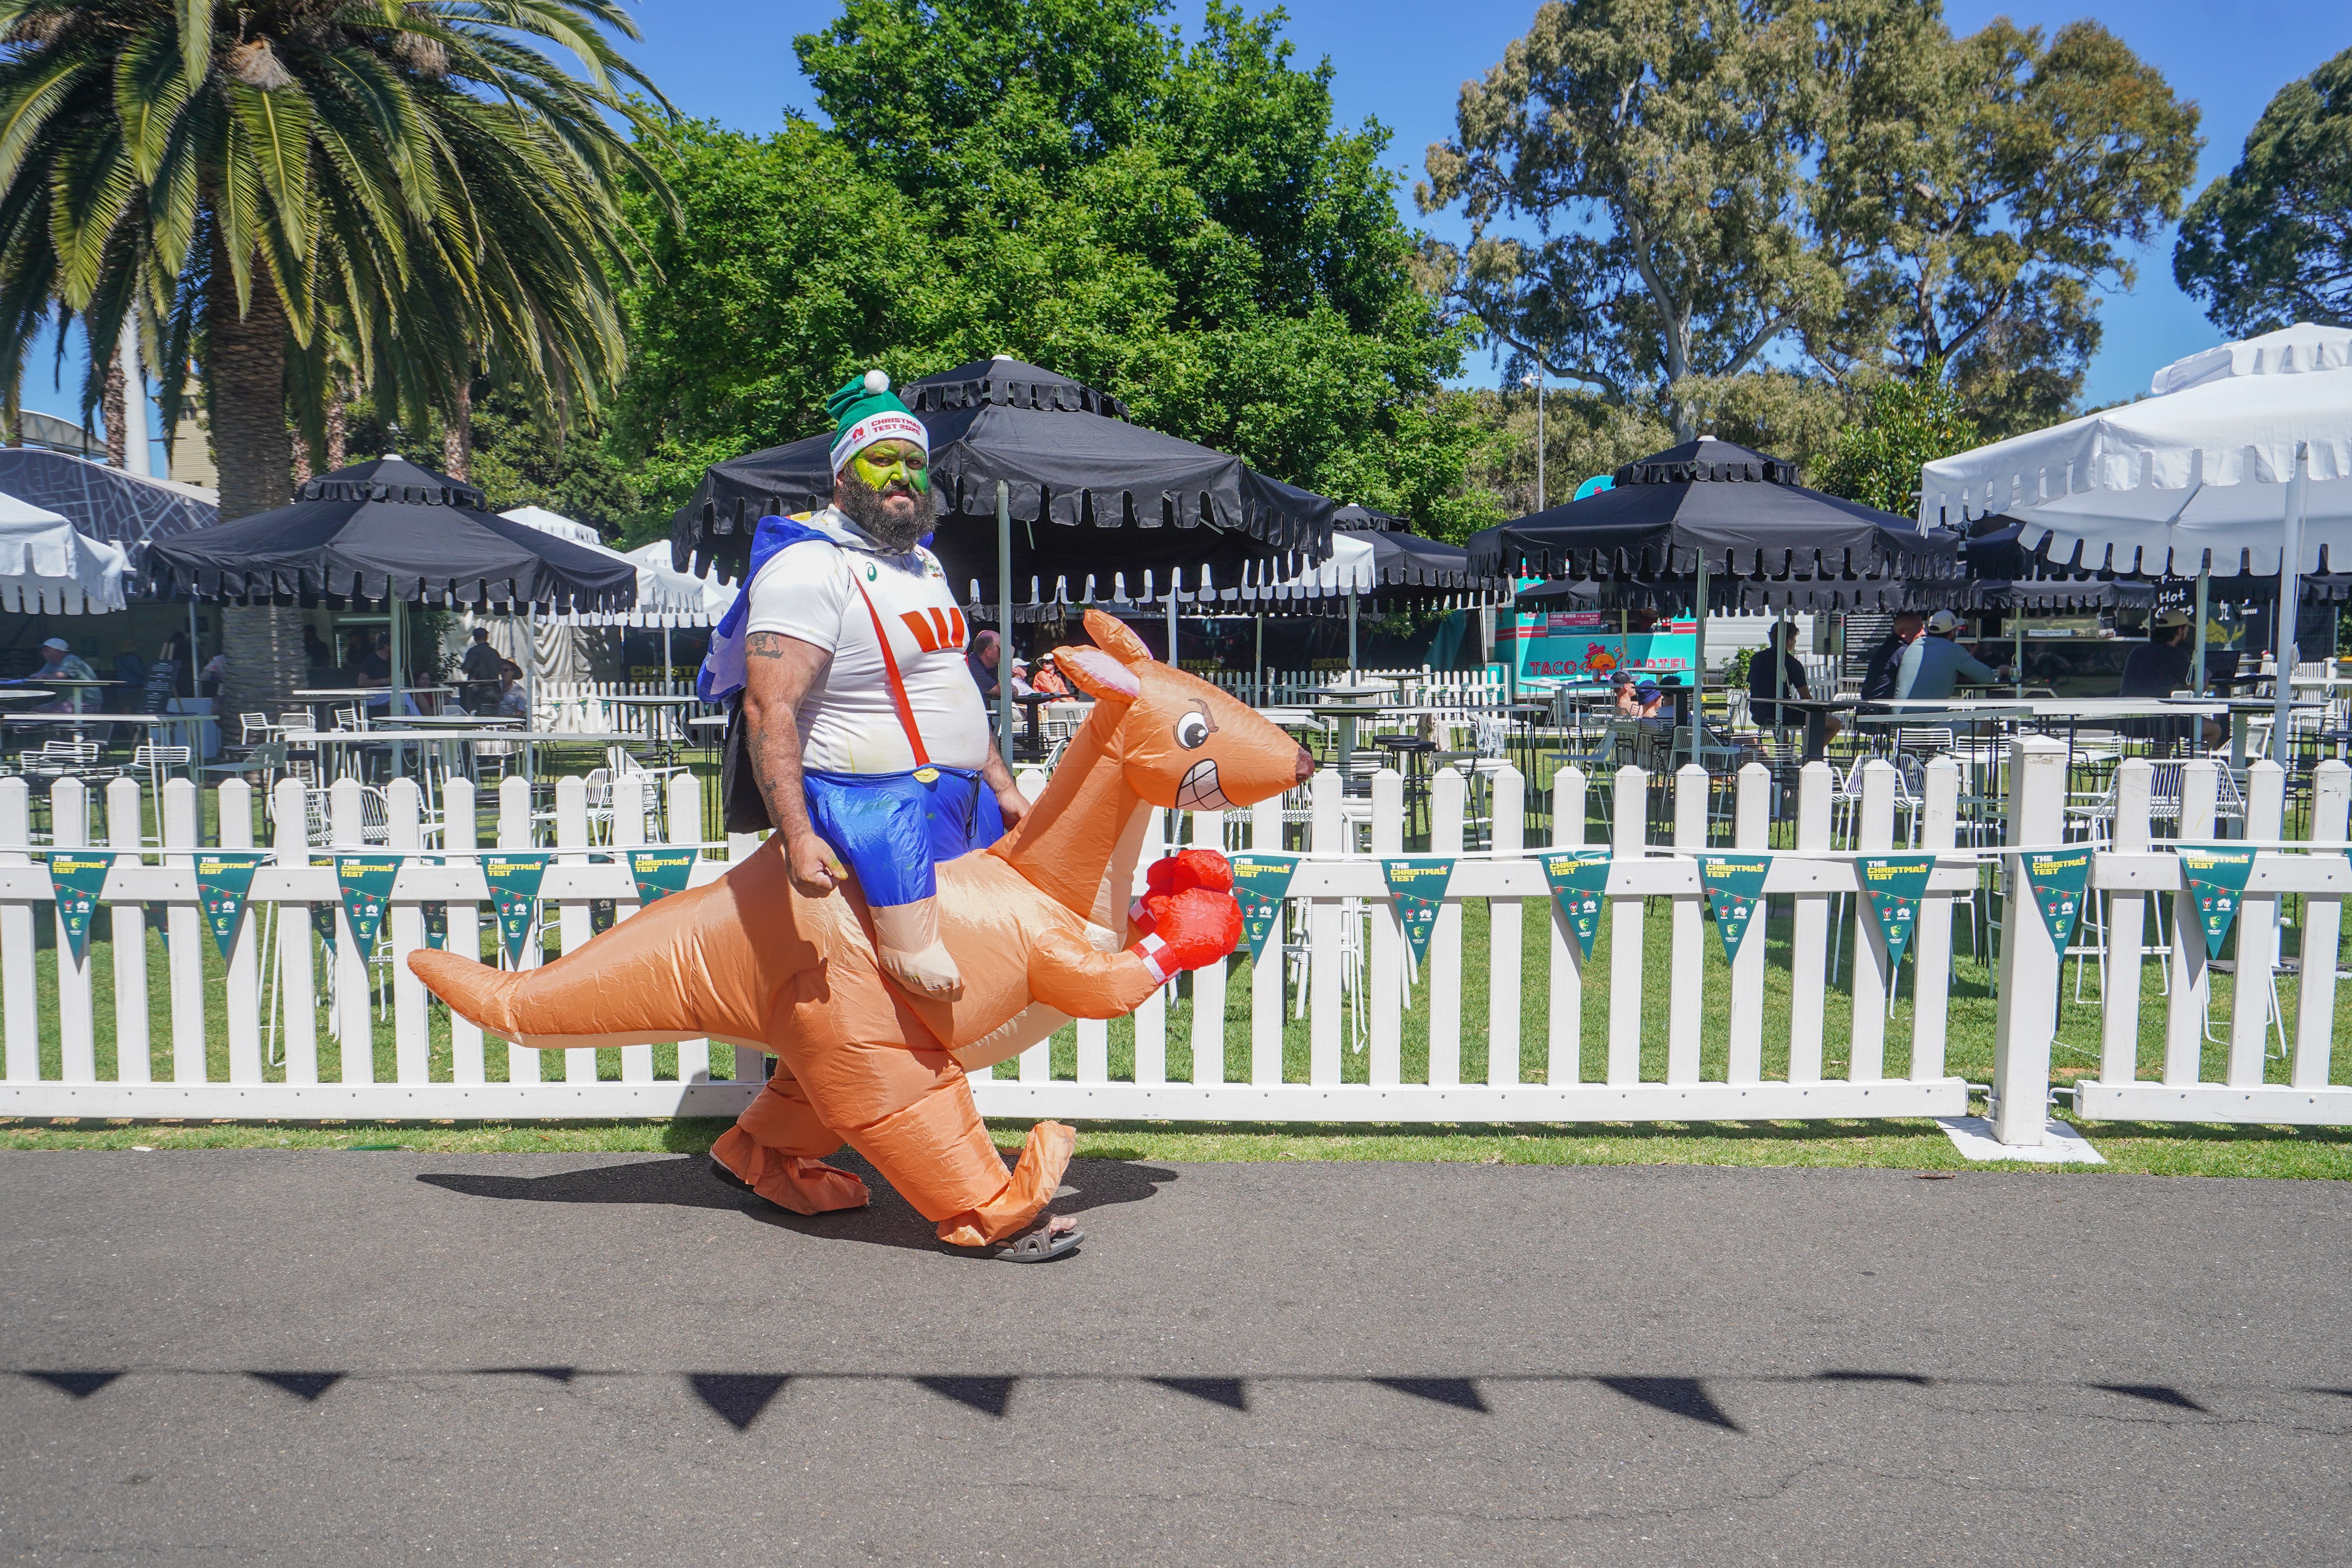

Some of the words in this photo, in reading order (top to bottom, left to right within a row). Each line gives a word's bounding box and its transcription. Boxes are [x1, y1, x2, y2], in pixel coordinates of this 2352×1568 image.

[871, 418, 921, 431] CHRISTMAS
[873, 424, 897, 432] TEST
[899, 425, 920, 435] 2025
[2159, 588, 2186, 604] Hot
[1529, 661, 1577, 675] TACO
[1548, 855, 1568, 864] THE
[2032, 859, 2086, 869] CHRISTMAS
[1233, 864, 1290, 873] CHRISTMAS
[1550, 867, 1576, 876] TEST
[1706, 864, 1764, 872] CHRISTMAS
